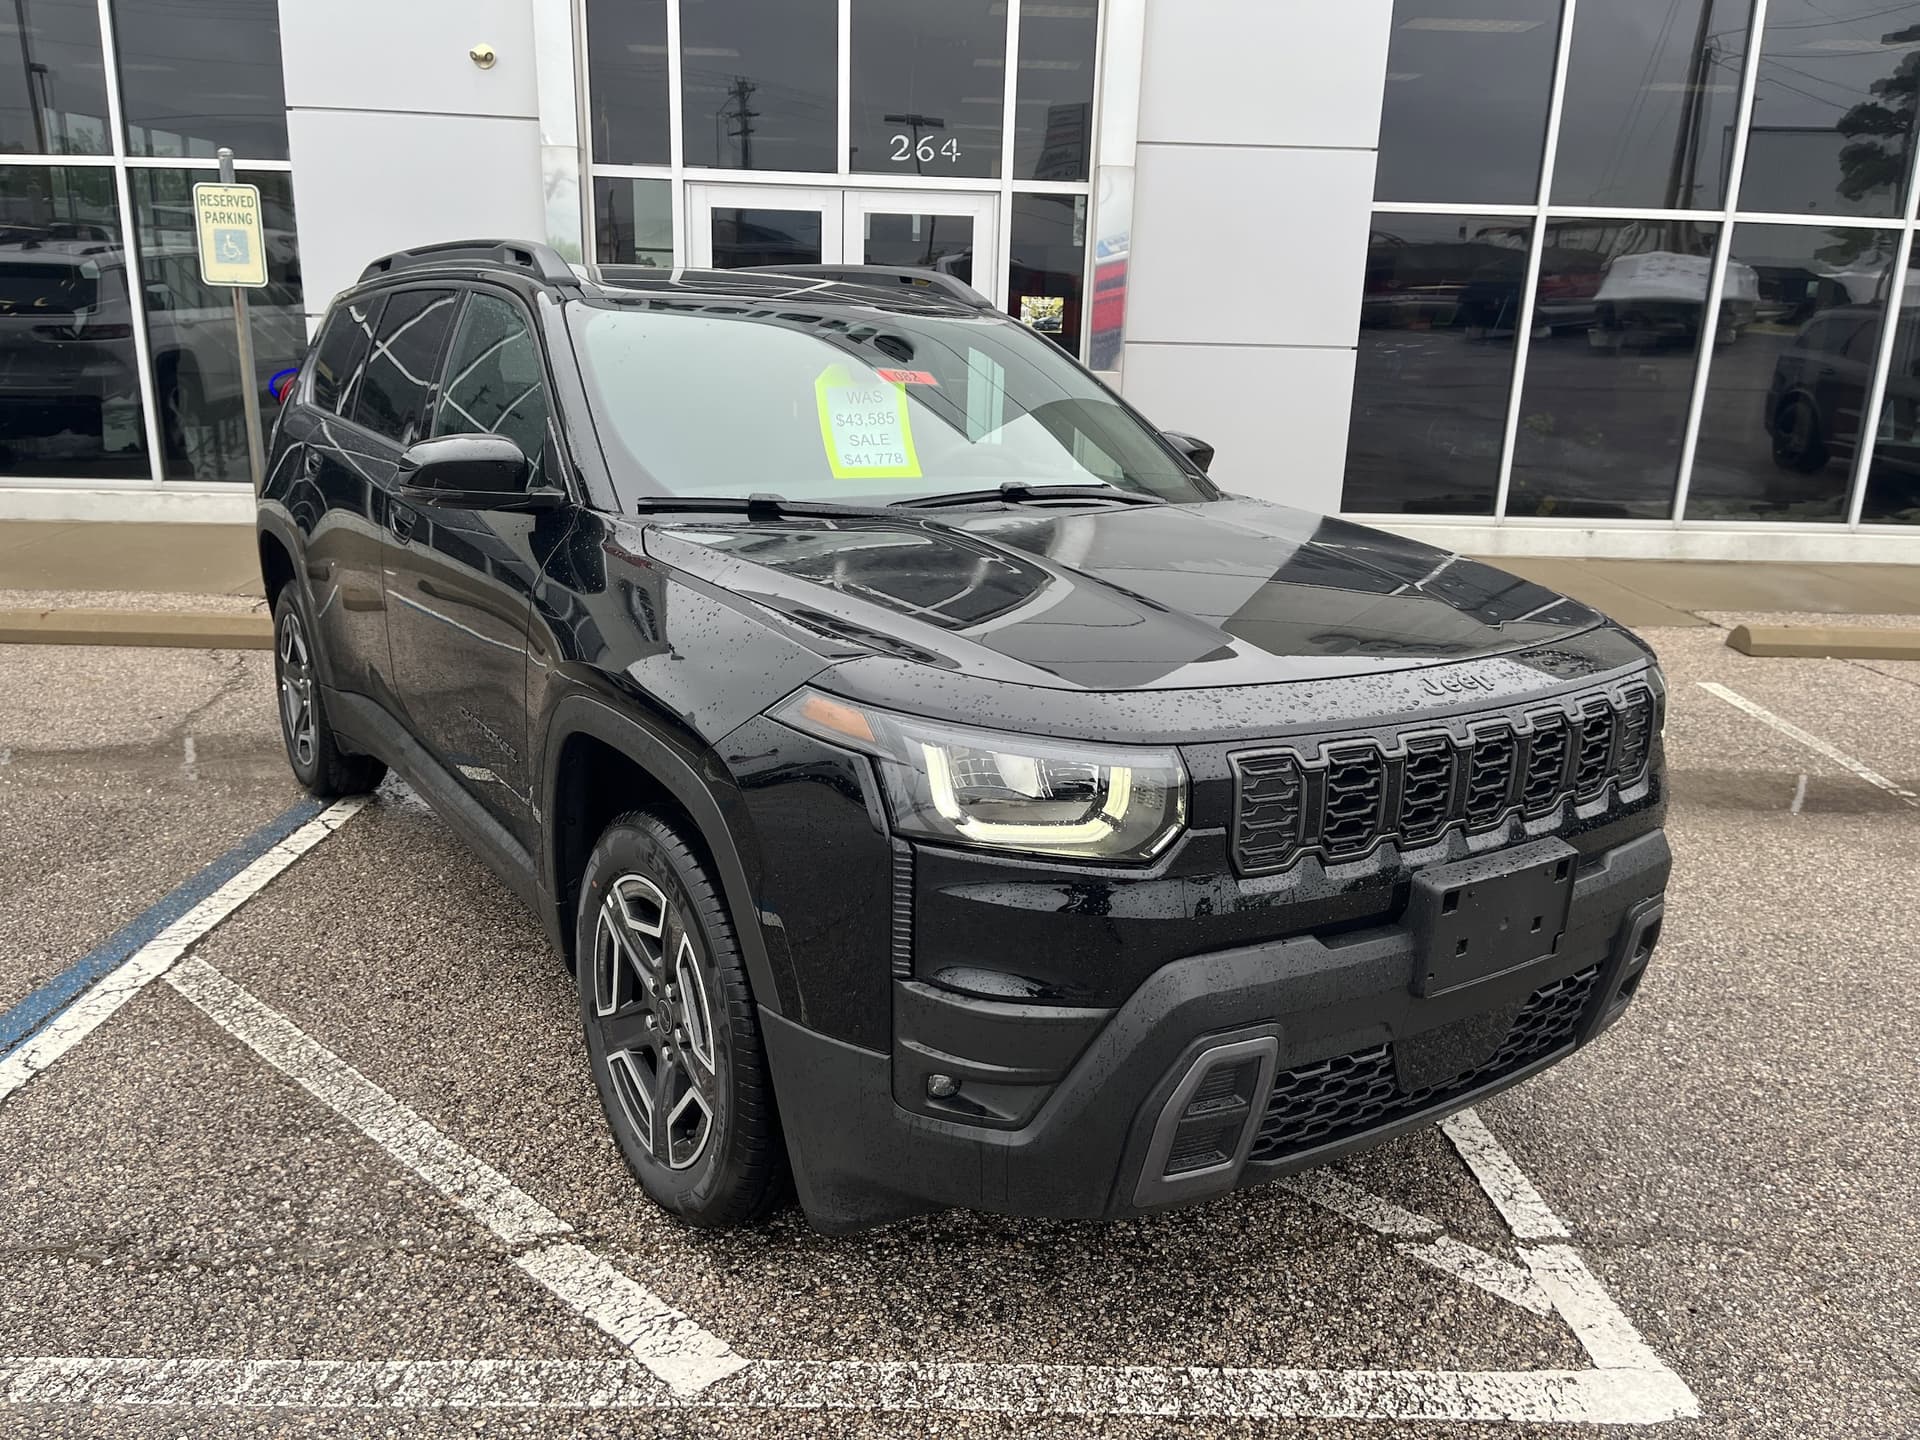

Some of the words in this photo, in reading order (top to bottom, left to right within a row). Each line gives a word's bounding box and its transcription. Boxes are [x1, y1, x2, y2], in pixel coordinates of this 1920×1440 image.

[890, 134, 962, 163] 264
[200, 194, 254, 208] RESERVED
[204, 211, 253, 225] PARKING
[894, 371, 921, 382] 082
[846, 390, 883, 404] WAS
[836, 411, 895, 428] $43,585
[849, 433, 891, 447] SALE
[844, 452, 904, 466] $41,778
[1421, 675, 1495, 696] Jeep
